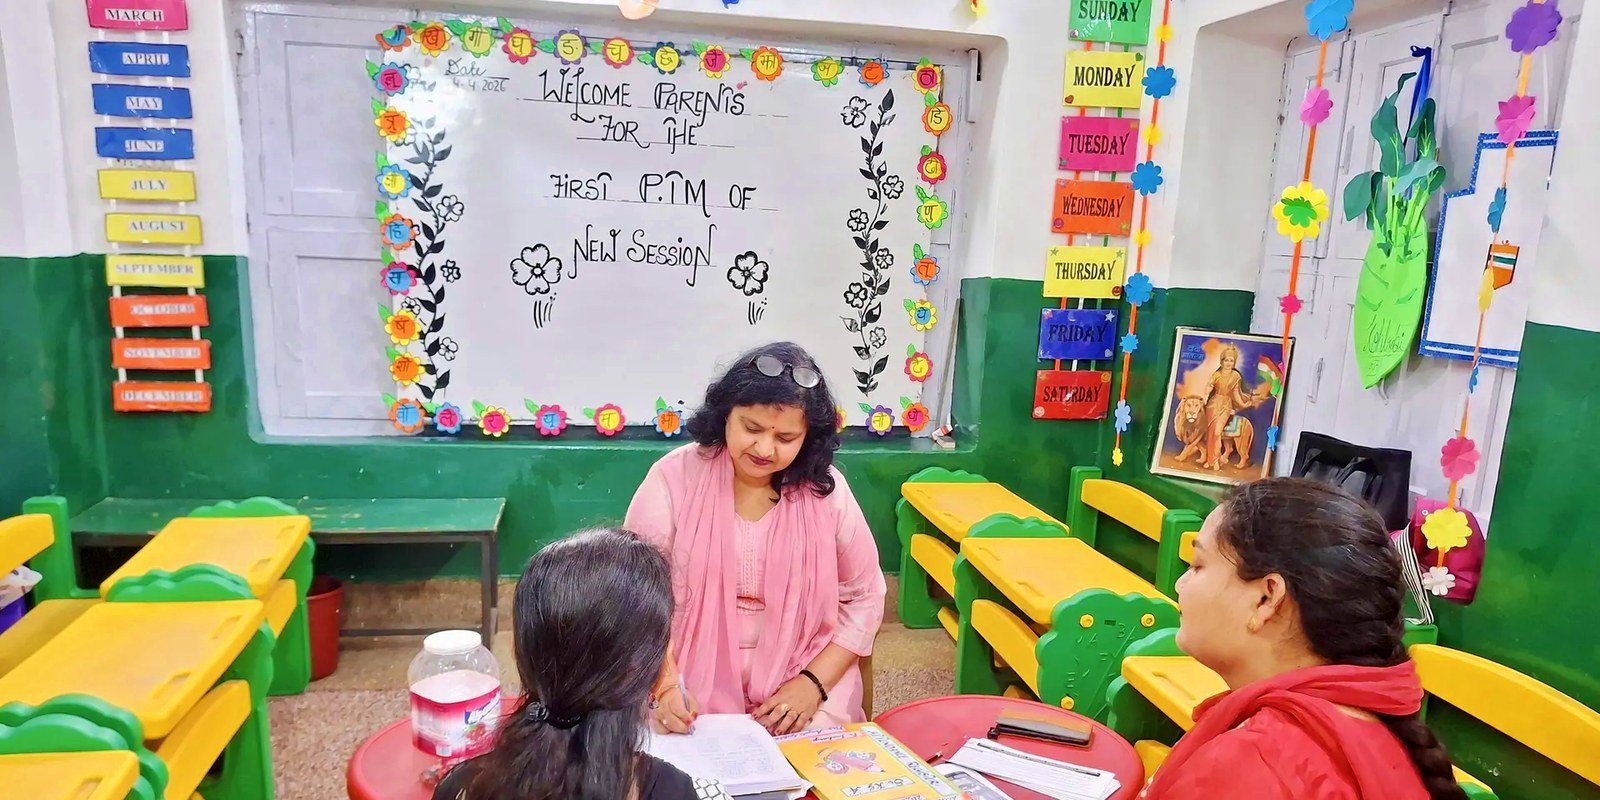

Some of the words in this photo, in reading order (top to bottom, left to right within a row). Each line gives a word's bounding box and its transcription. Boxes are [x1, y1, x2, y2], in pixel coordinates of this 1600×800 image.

[107, 9, 163, 21] MARCH
[1078, 0, 1141, 22] SUNDAY
[125, 53, 169, 65] APRIL
[446, 57, 487, 76] Date
[1073, 64, 1136, 88] MONDAY
[128, 97, 161, 109] MAY
[598, 114, 650, 148] FOR
[663, 117, 698, 154] THE
[126, 140, 163, 152] JUNE
[1068, 133, 1130, 156] TUESDAY
[131, 179, 167, 191] JULY
[729, 184, 757, 210] OF
[1062, 193, 1125, 218] WEDNESDAY
[129, 220, 187, 232] AUGUST
[567, 224, 621, 279] NEW
[115, 263, 195, 274] SEPTEMBER
[1055, 260, 1116, 281] THURSDAY
[1048, 322, 1110, 344] FRIDAY
[125, 347, 199, 358] NOVEMBER
[123, 390, 201, 401] DECEMBER
[1043, 382, 1103, 404] SATURDAY
